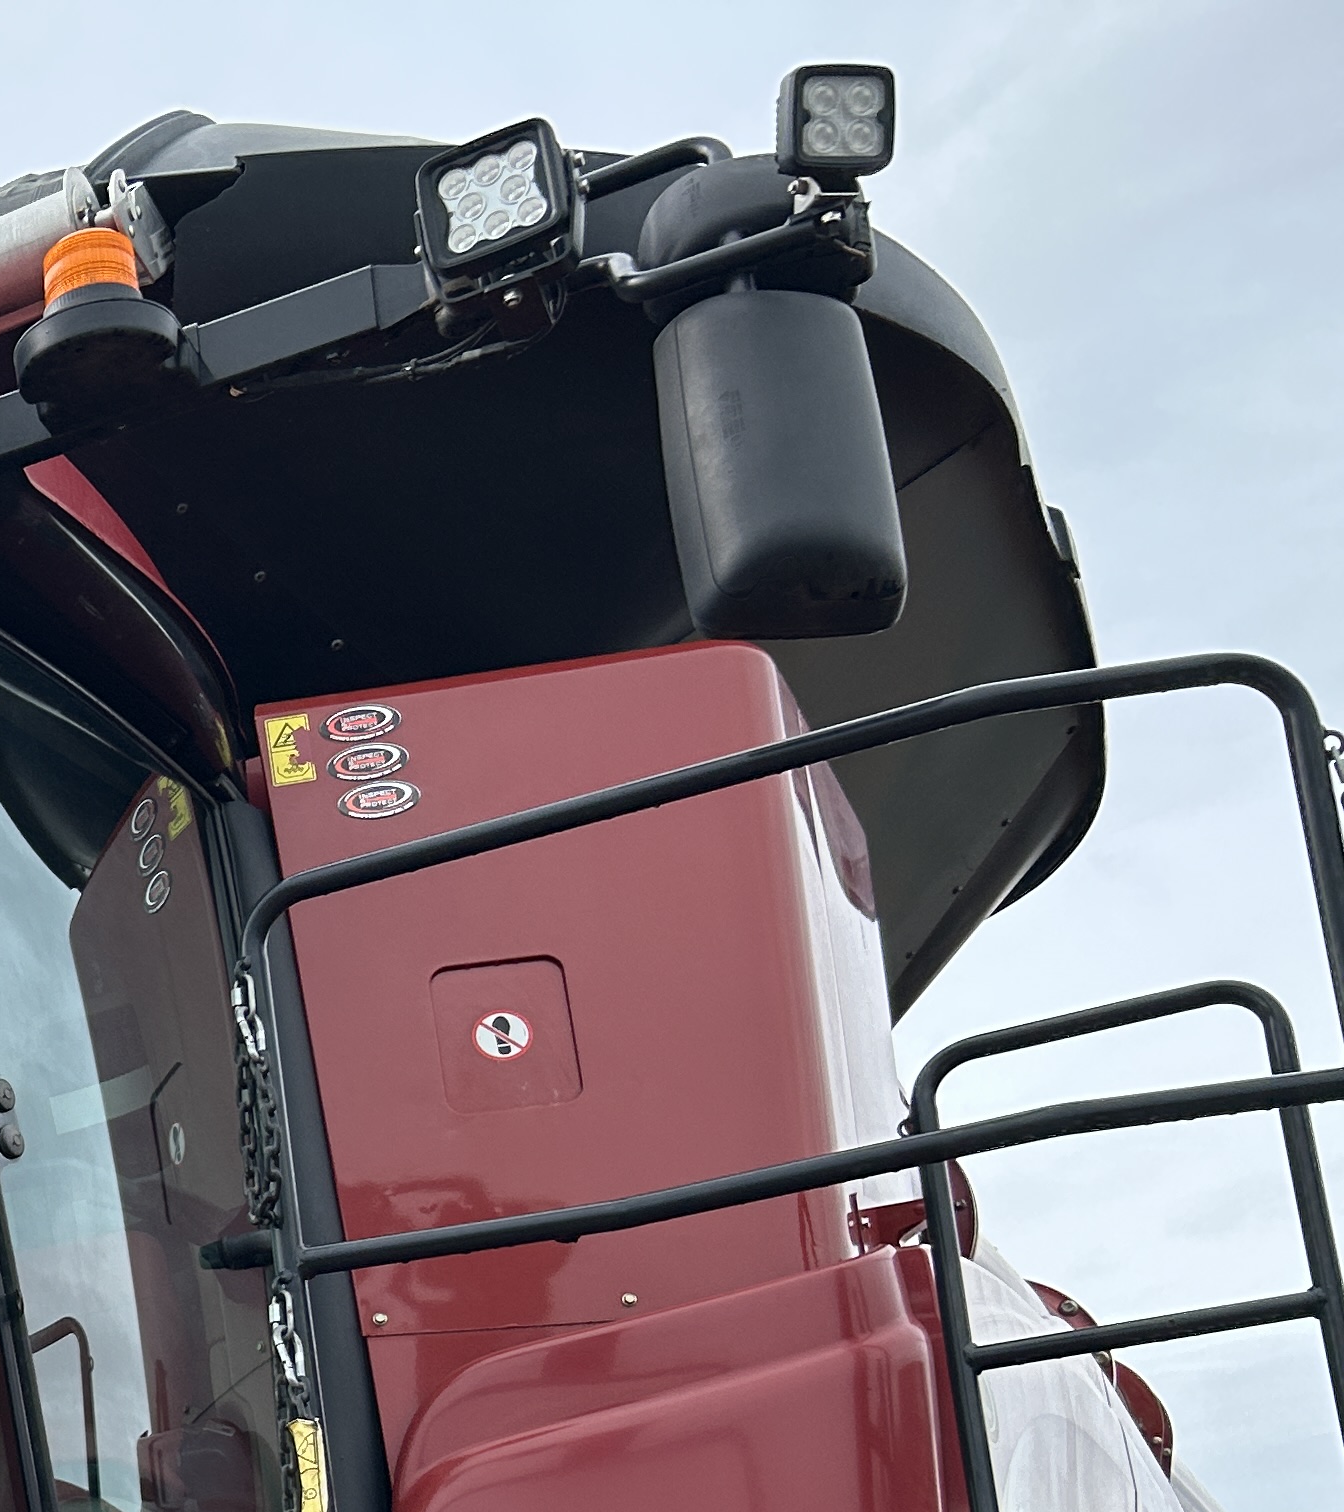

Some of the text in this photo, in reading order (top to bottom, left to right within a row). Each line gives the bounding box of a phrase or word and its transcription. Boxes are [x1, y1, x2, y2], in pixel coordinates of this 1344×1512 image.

[339, 711, 378, 723] INSPECT
[341, 722, 379, 732] PROTECT
[348, 750, 385, 762] INSPECT
[348, 761, 386, 771] PROTECT
[358, 788, 397, 800] INSPECT
[359, 799, 398, 809] PROTECT
